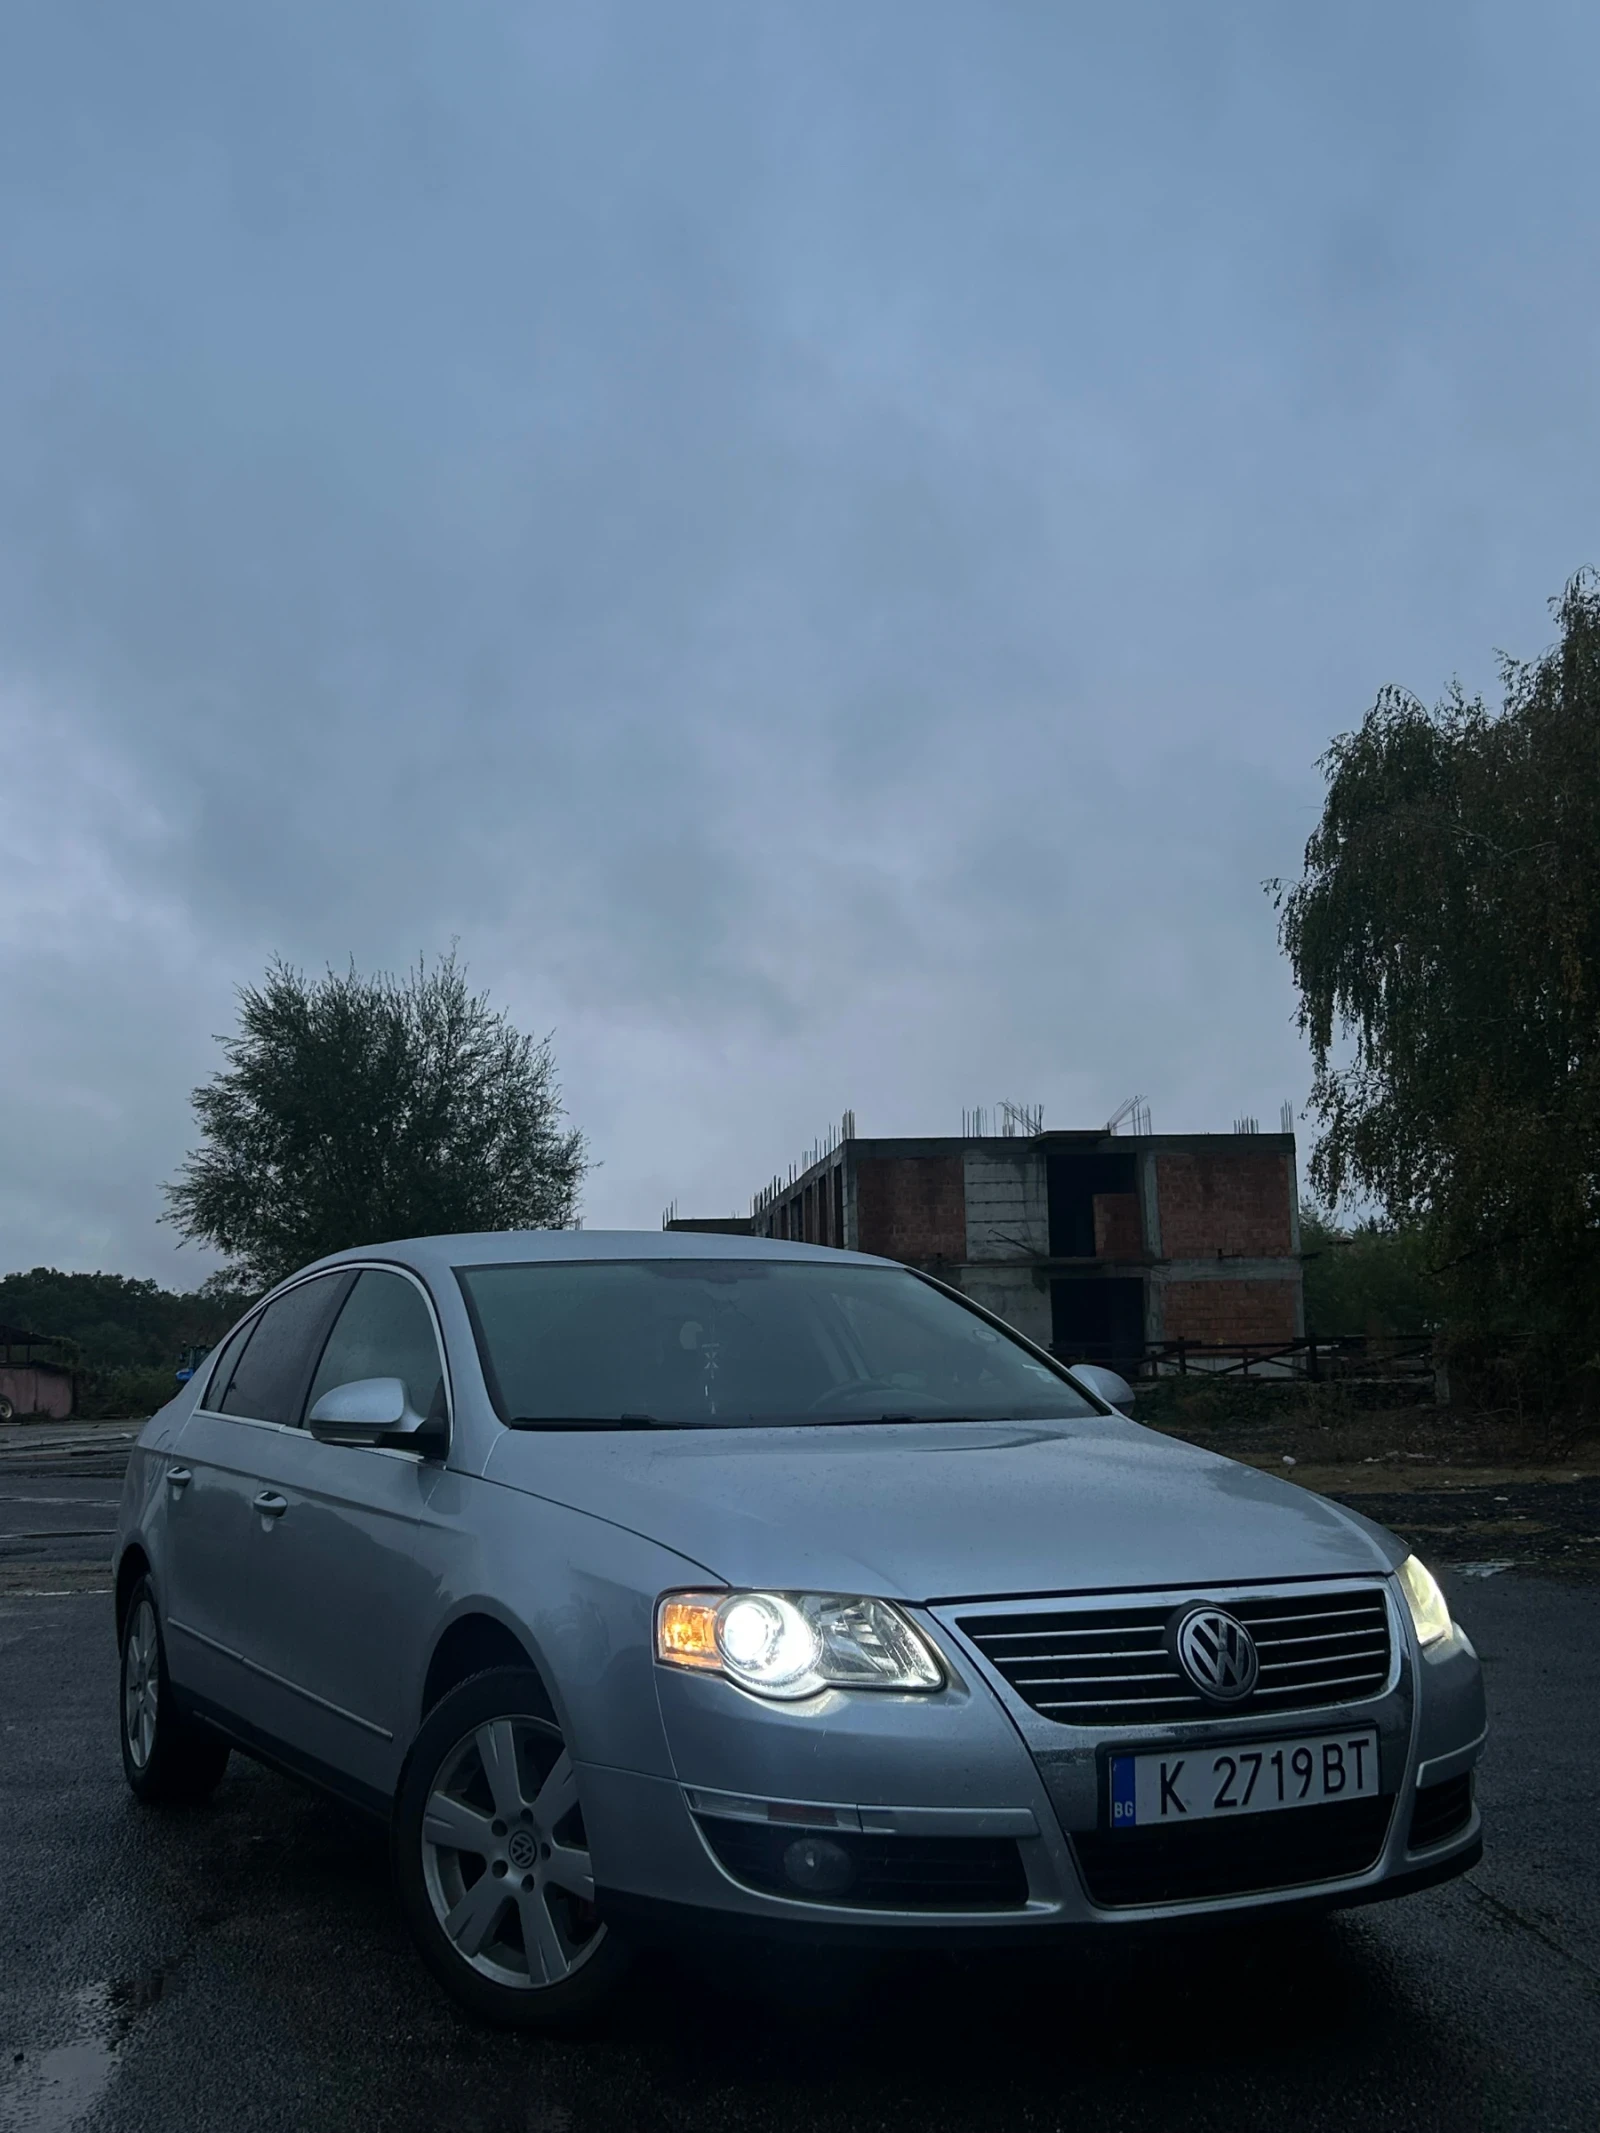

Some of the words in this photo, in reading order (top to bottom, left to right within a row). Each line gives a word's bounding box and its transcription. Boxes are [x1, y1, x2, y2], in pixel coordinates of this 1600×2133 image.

[1181, 1610, 1256, 1697] VW
[1114, 1801, 1134, 1818] BG
[1160, 1760, 1187, 1816] K
